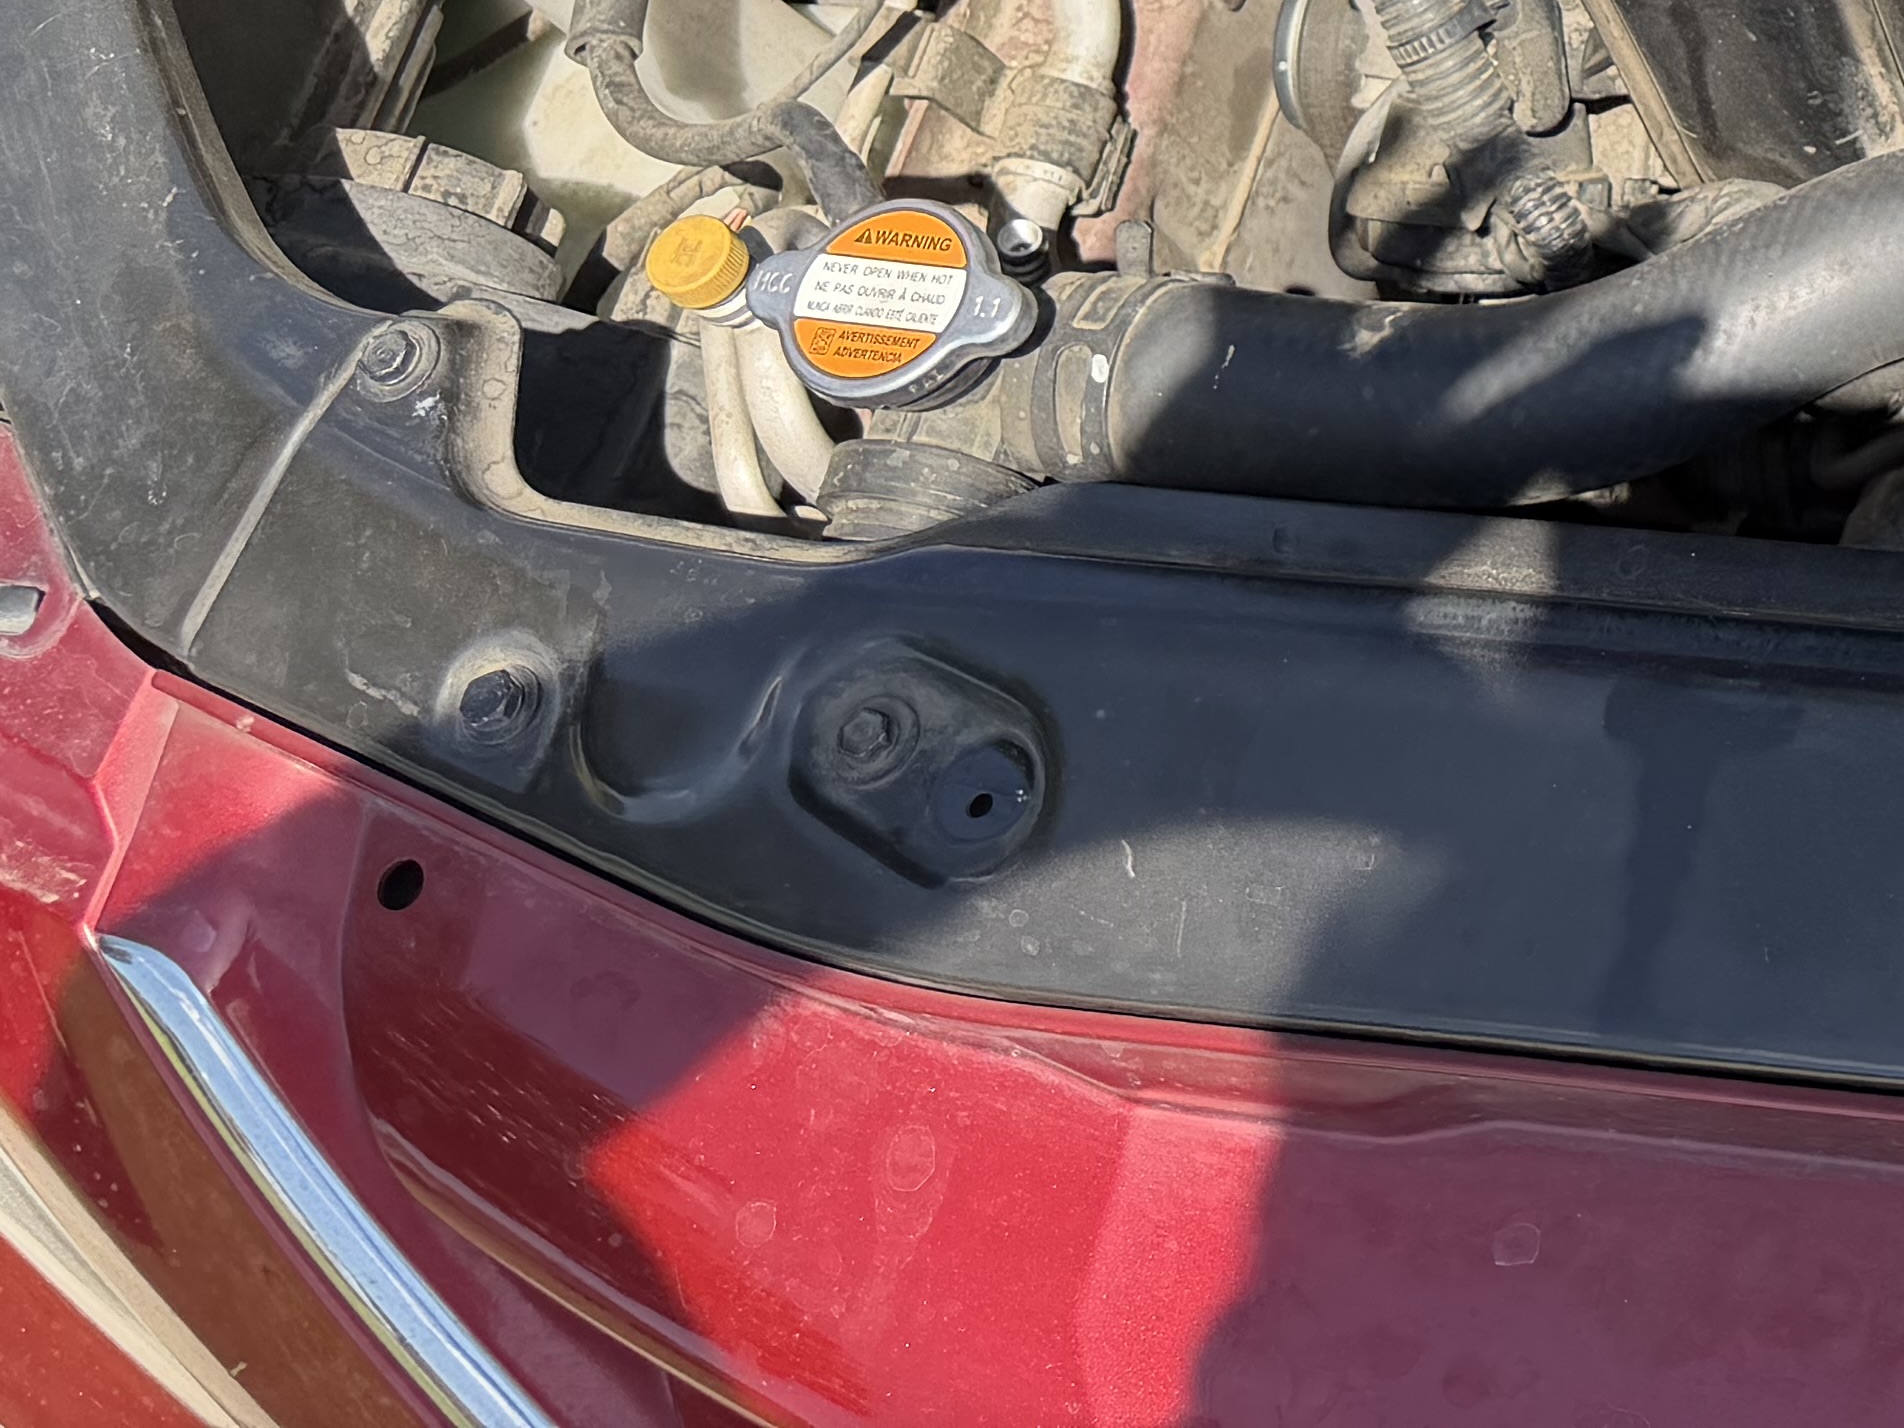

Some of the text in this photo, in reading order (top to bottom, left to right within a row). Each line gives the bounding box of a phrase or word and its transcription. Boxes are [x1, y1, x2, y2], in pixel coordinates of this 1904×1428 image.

[873, 230, 952, 253] WARNING
[823, 261, 954, 286] NEVER OPEN WHEN HOT
[814, 280, 829, 292] NE
[833, 282, 853, 295] PAS
[973, 295, 1002, 318] 1.1
[838, 329, 922, 350] AVERTISSEMENT
[833, 346, 902, 364] ADVERTENCIA
